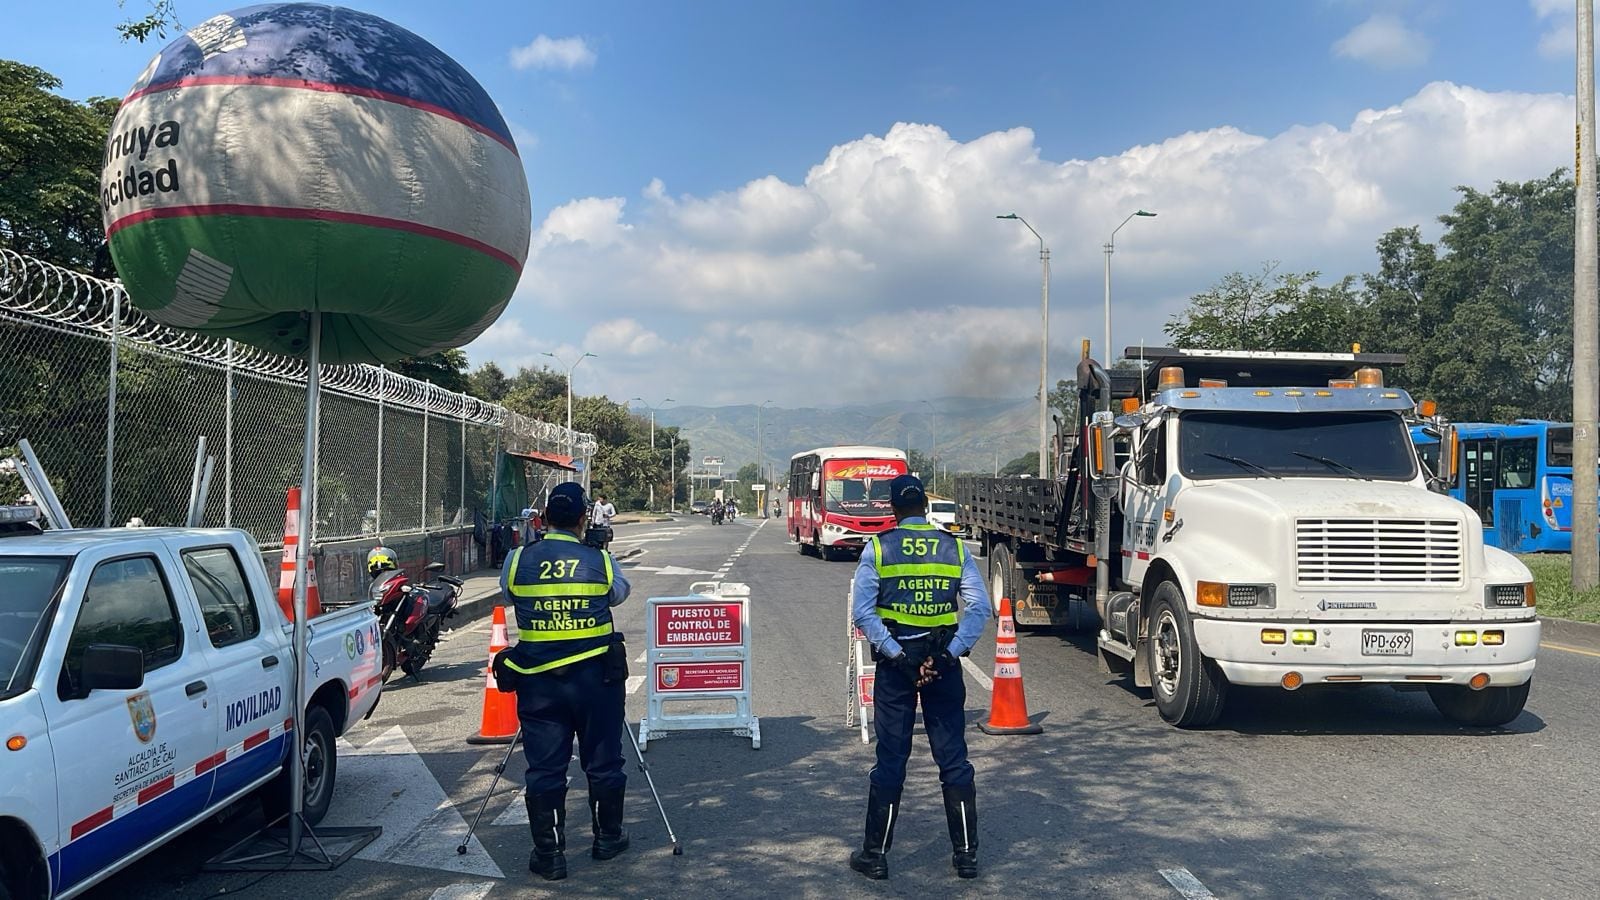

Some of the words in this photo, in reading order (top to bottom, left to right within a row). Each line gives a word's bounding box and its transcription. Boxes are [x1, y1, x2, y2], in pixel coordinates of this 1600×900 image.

[901, 537, 940, 556] 557
[539, 559, 580, 579] 237
[897, 578, 950, 590] AGENTE
[914, 591, 933, 602] DE
[533, 599, 590, 610] AGENTE
[891, 602, 952, 616] TRANSITO
[552, 611, 571, 621] DE
[671, 608, 711, 618] PUESTO
[713, 608, 727, 617] DE
[530, 617, 596, 631] TRANSITO
[667, 620, 715, 630] CONTROL
[717, 619, 731, 629] DE
[666, 631, 732, 642] EMBRIAGUEZ
[225, 685, 281, 732] MOVILIDAD
[159, 742, 167, 754] DE
[114, 761, 150, 786] SANTIAGO
[152, 755, 161, 768] DE
[162, 748, 177, 763] CALI
